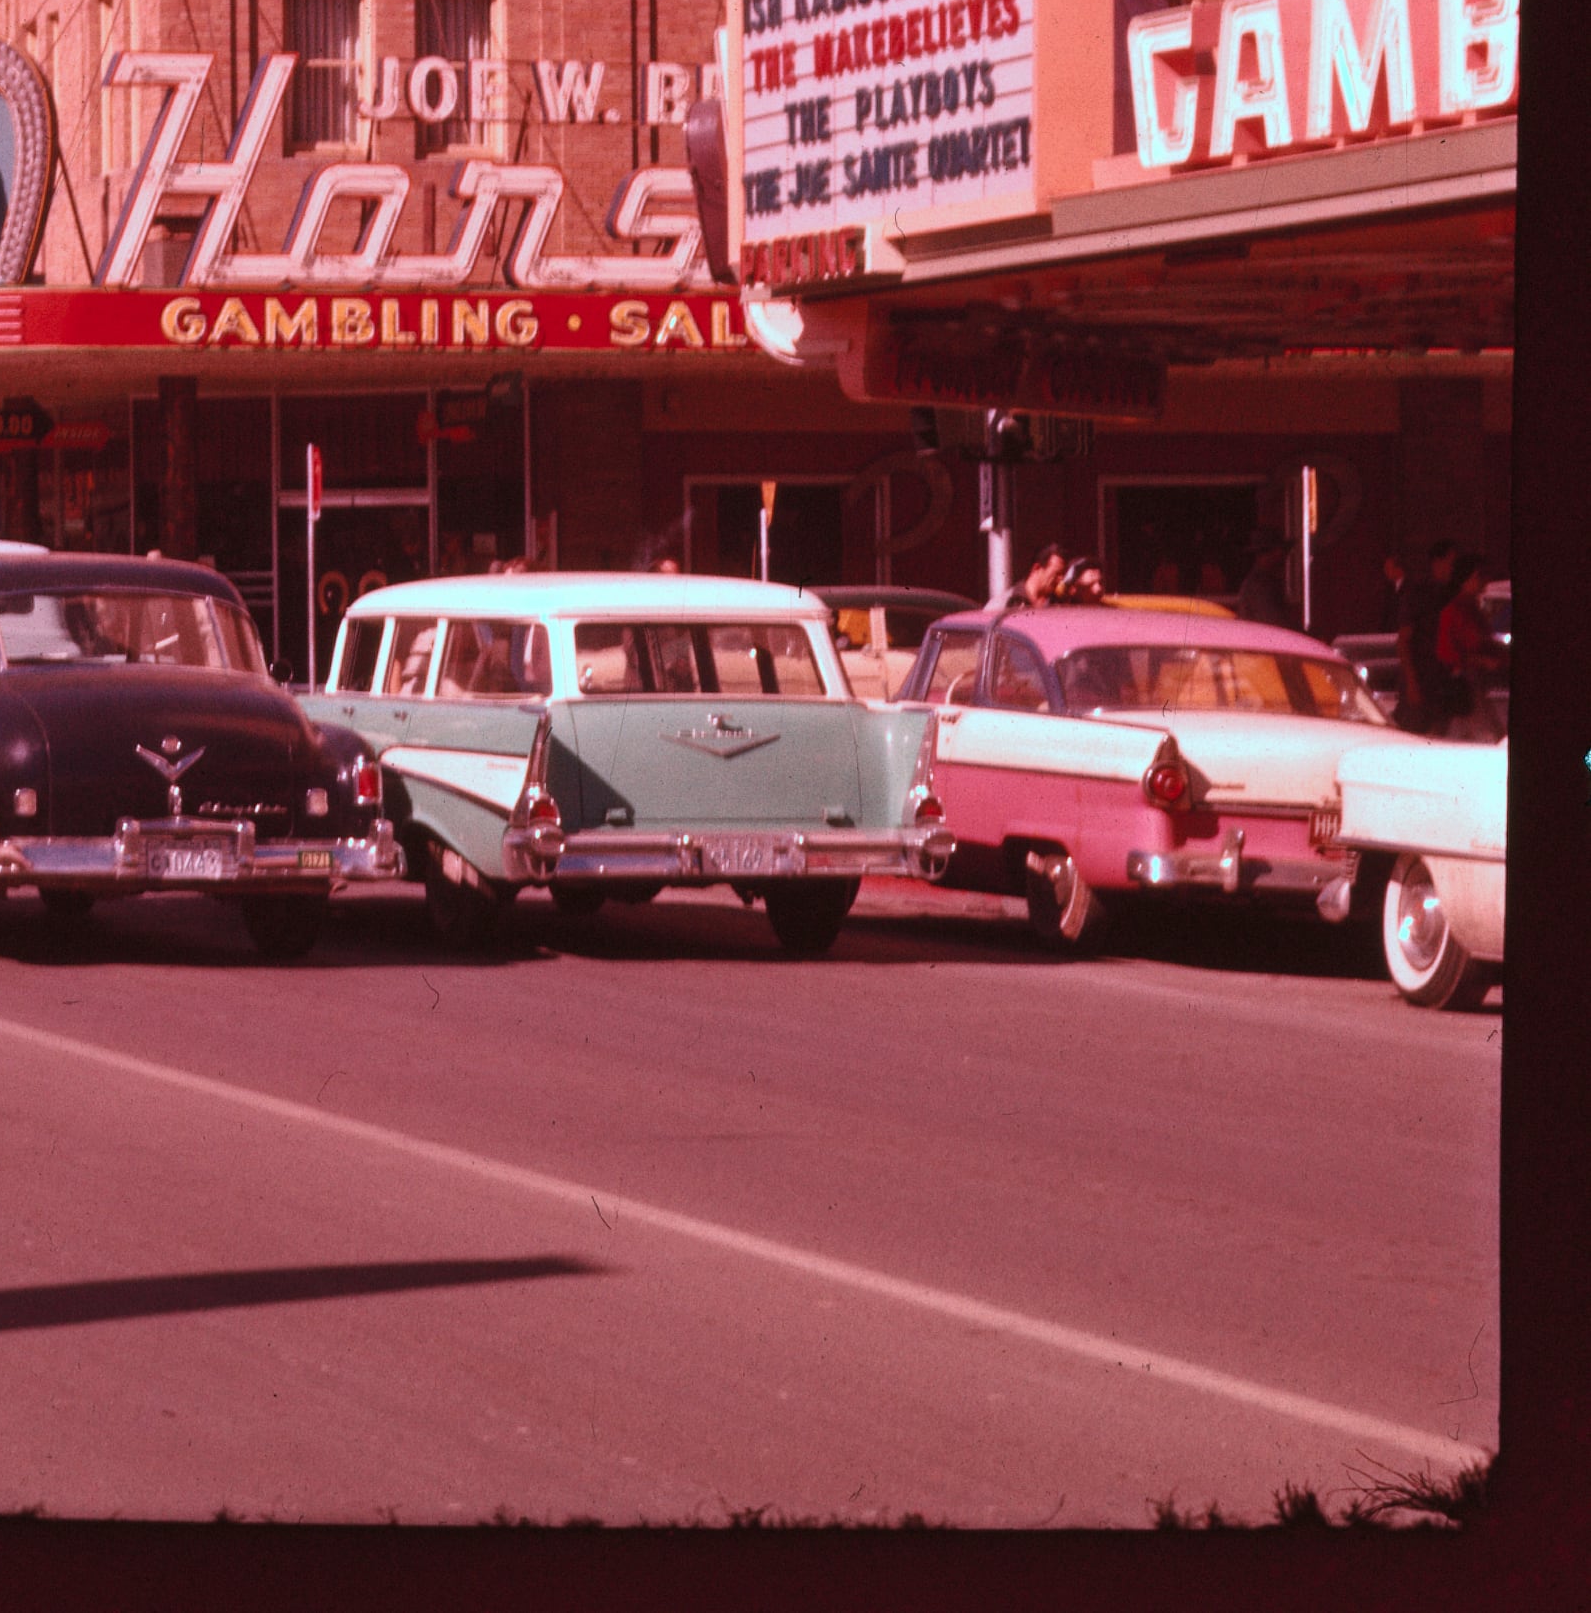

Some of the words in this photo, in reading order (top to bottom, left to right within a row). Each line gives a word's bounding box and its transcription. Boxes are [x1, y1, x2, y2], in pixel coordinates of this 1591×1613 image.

[358, 54, 503, 124] JOE
[536, 61, 621, 124] W.
[749, 40, 798, 96] THE
[783, 95, 832, 147] THE
[854, 58, 996, 132] PLAYBOYS
[742, 166, 781, 217] THE
[789, 157, 832, 208] JOE
[841, 140, 919, 200] SANTE
[927, 116, 1032, 182] QUARTET
[159, 294, 539, 348] GAMBLING
